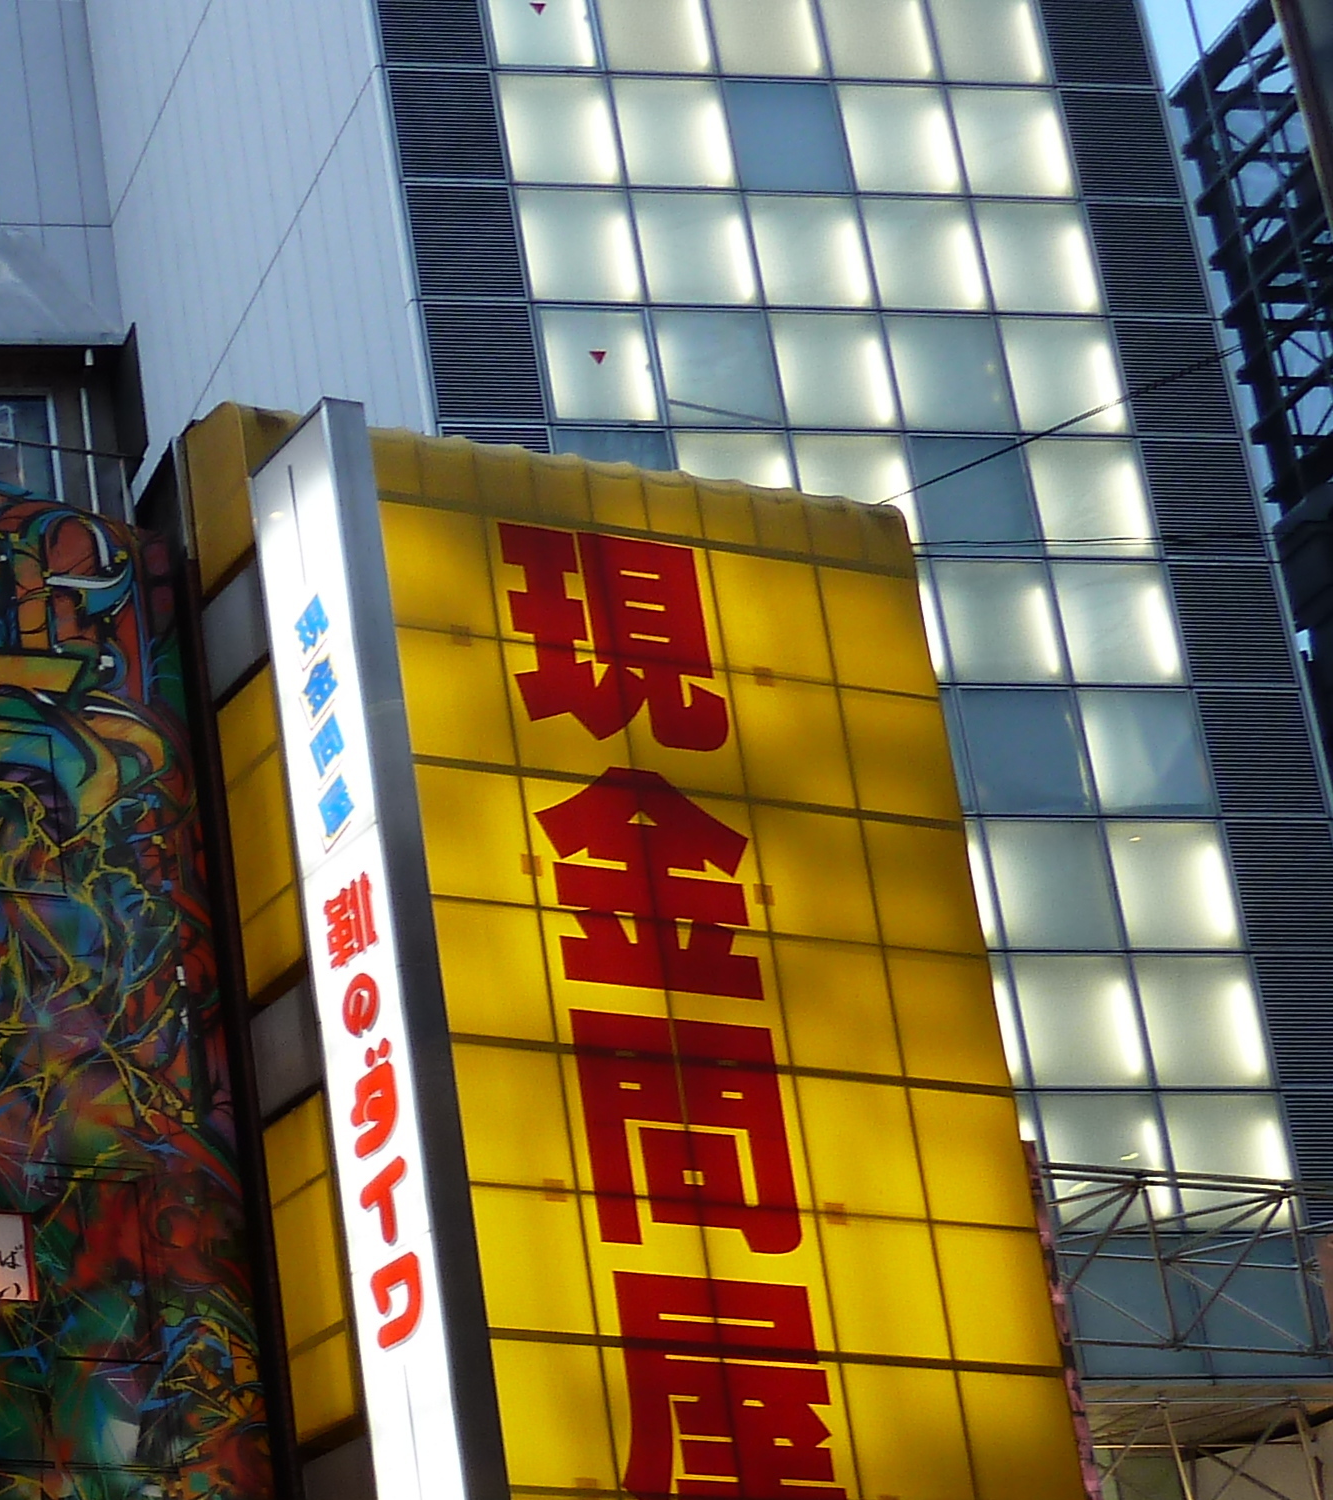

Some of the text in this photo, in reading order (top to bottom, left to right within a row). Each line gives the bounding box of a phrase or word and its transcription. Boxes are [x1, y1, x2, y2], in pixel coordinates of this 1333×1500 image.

[322, 870, 426, 1354] 靴のダイワ
